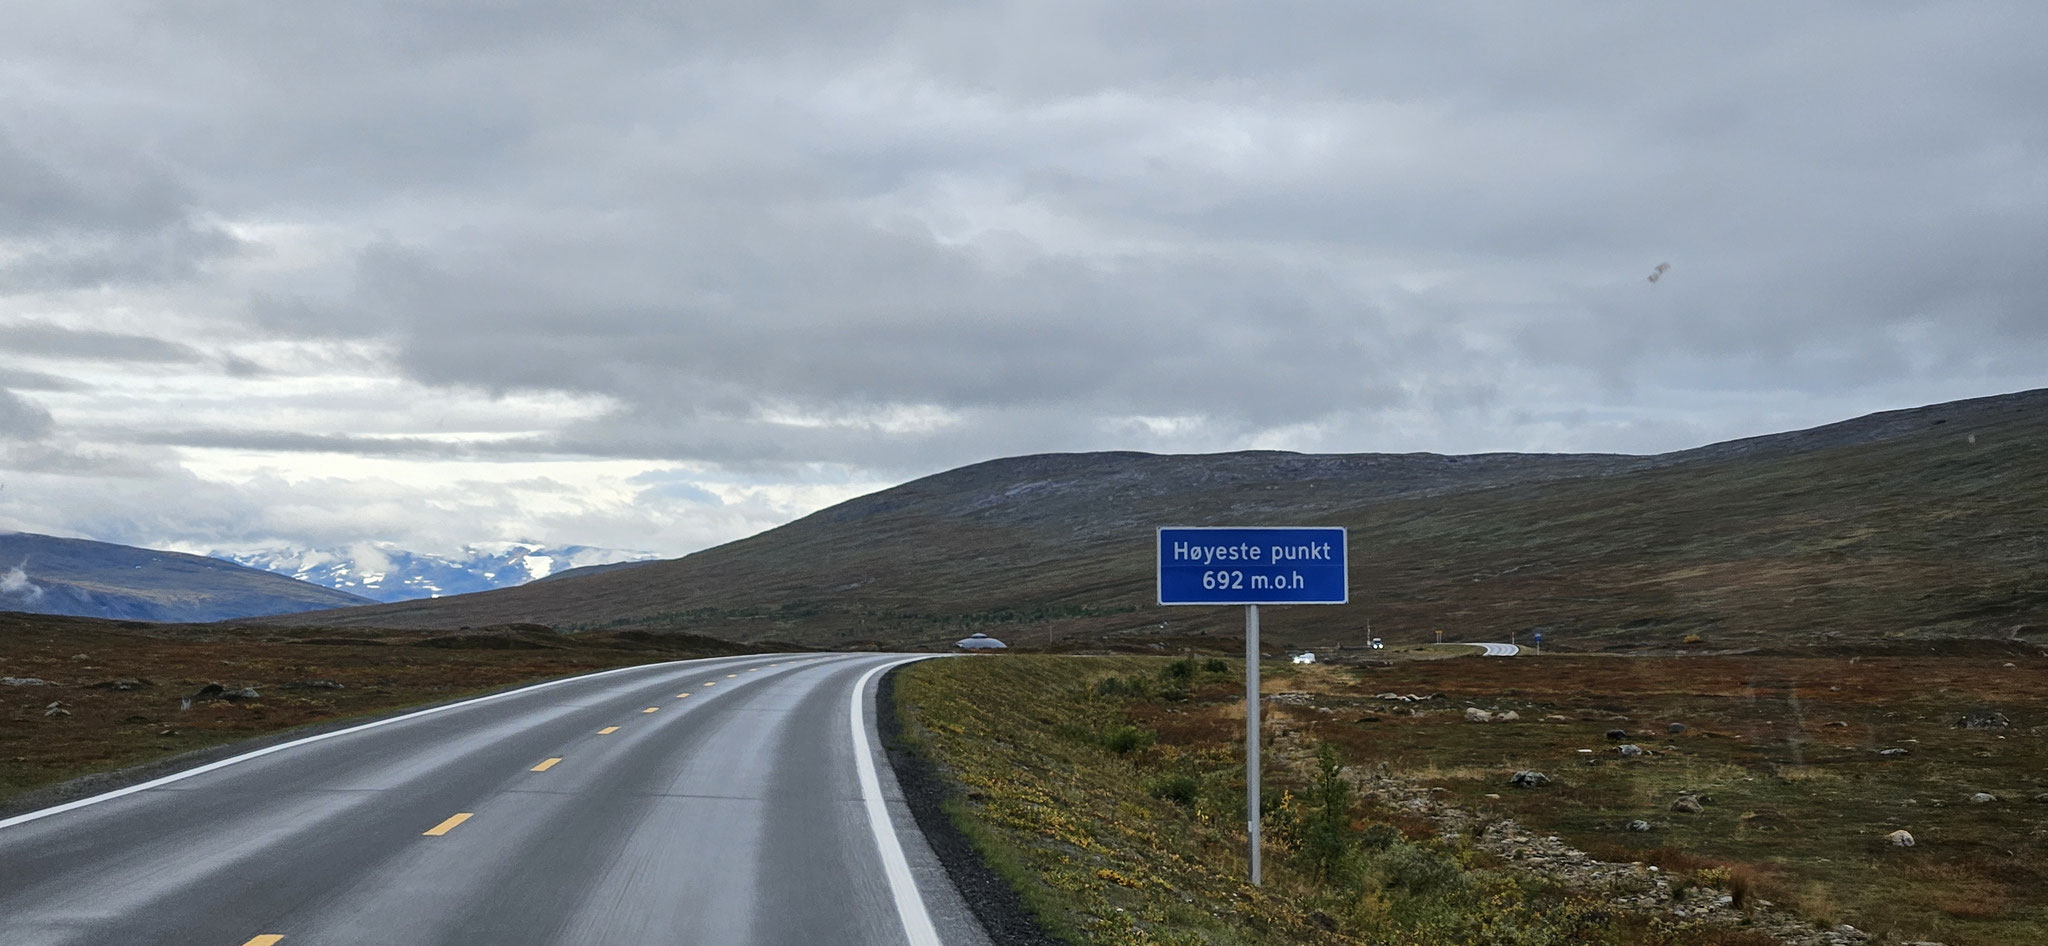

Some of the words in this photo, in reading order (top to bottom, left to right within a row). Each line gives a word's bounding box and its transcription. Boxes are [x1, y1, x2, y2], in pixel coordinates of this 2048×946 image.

[1173, 541, 1261, 565] Høyeste
[1271, 541, 1331, 565] punkt
[1202, 570, 1243, 590] 692
[1251, 570, 1304, 590] m.o.h
